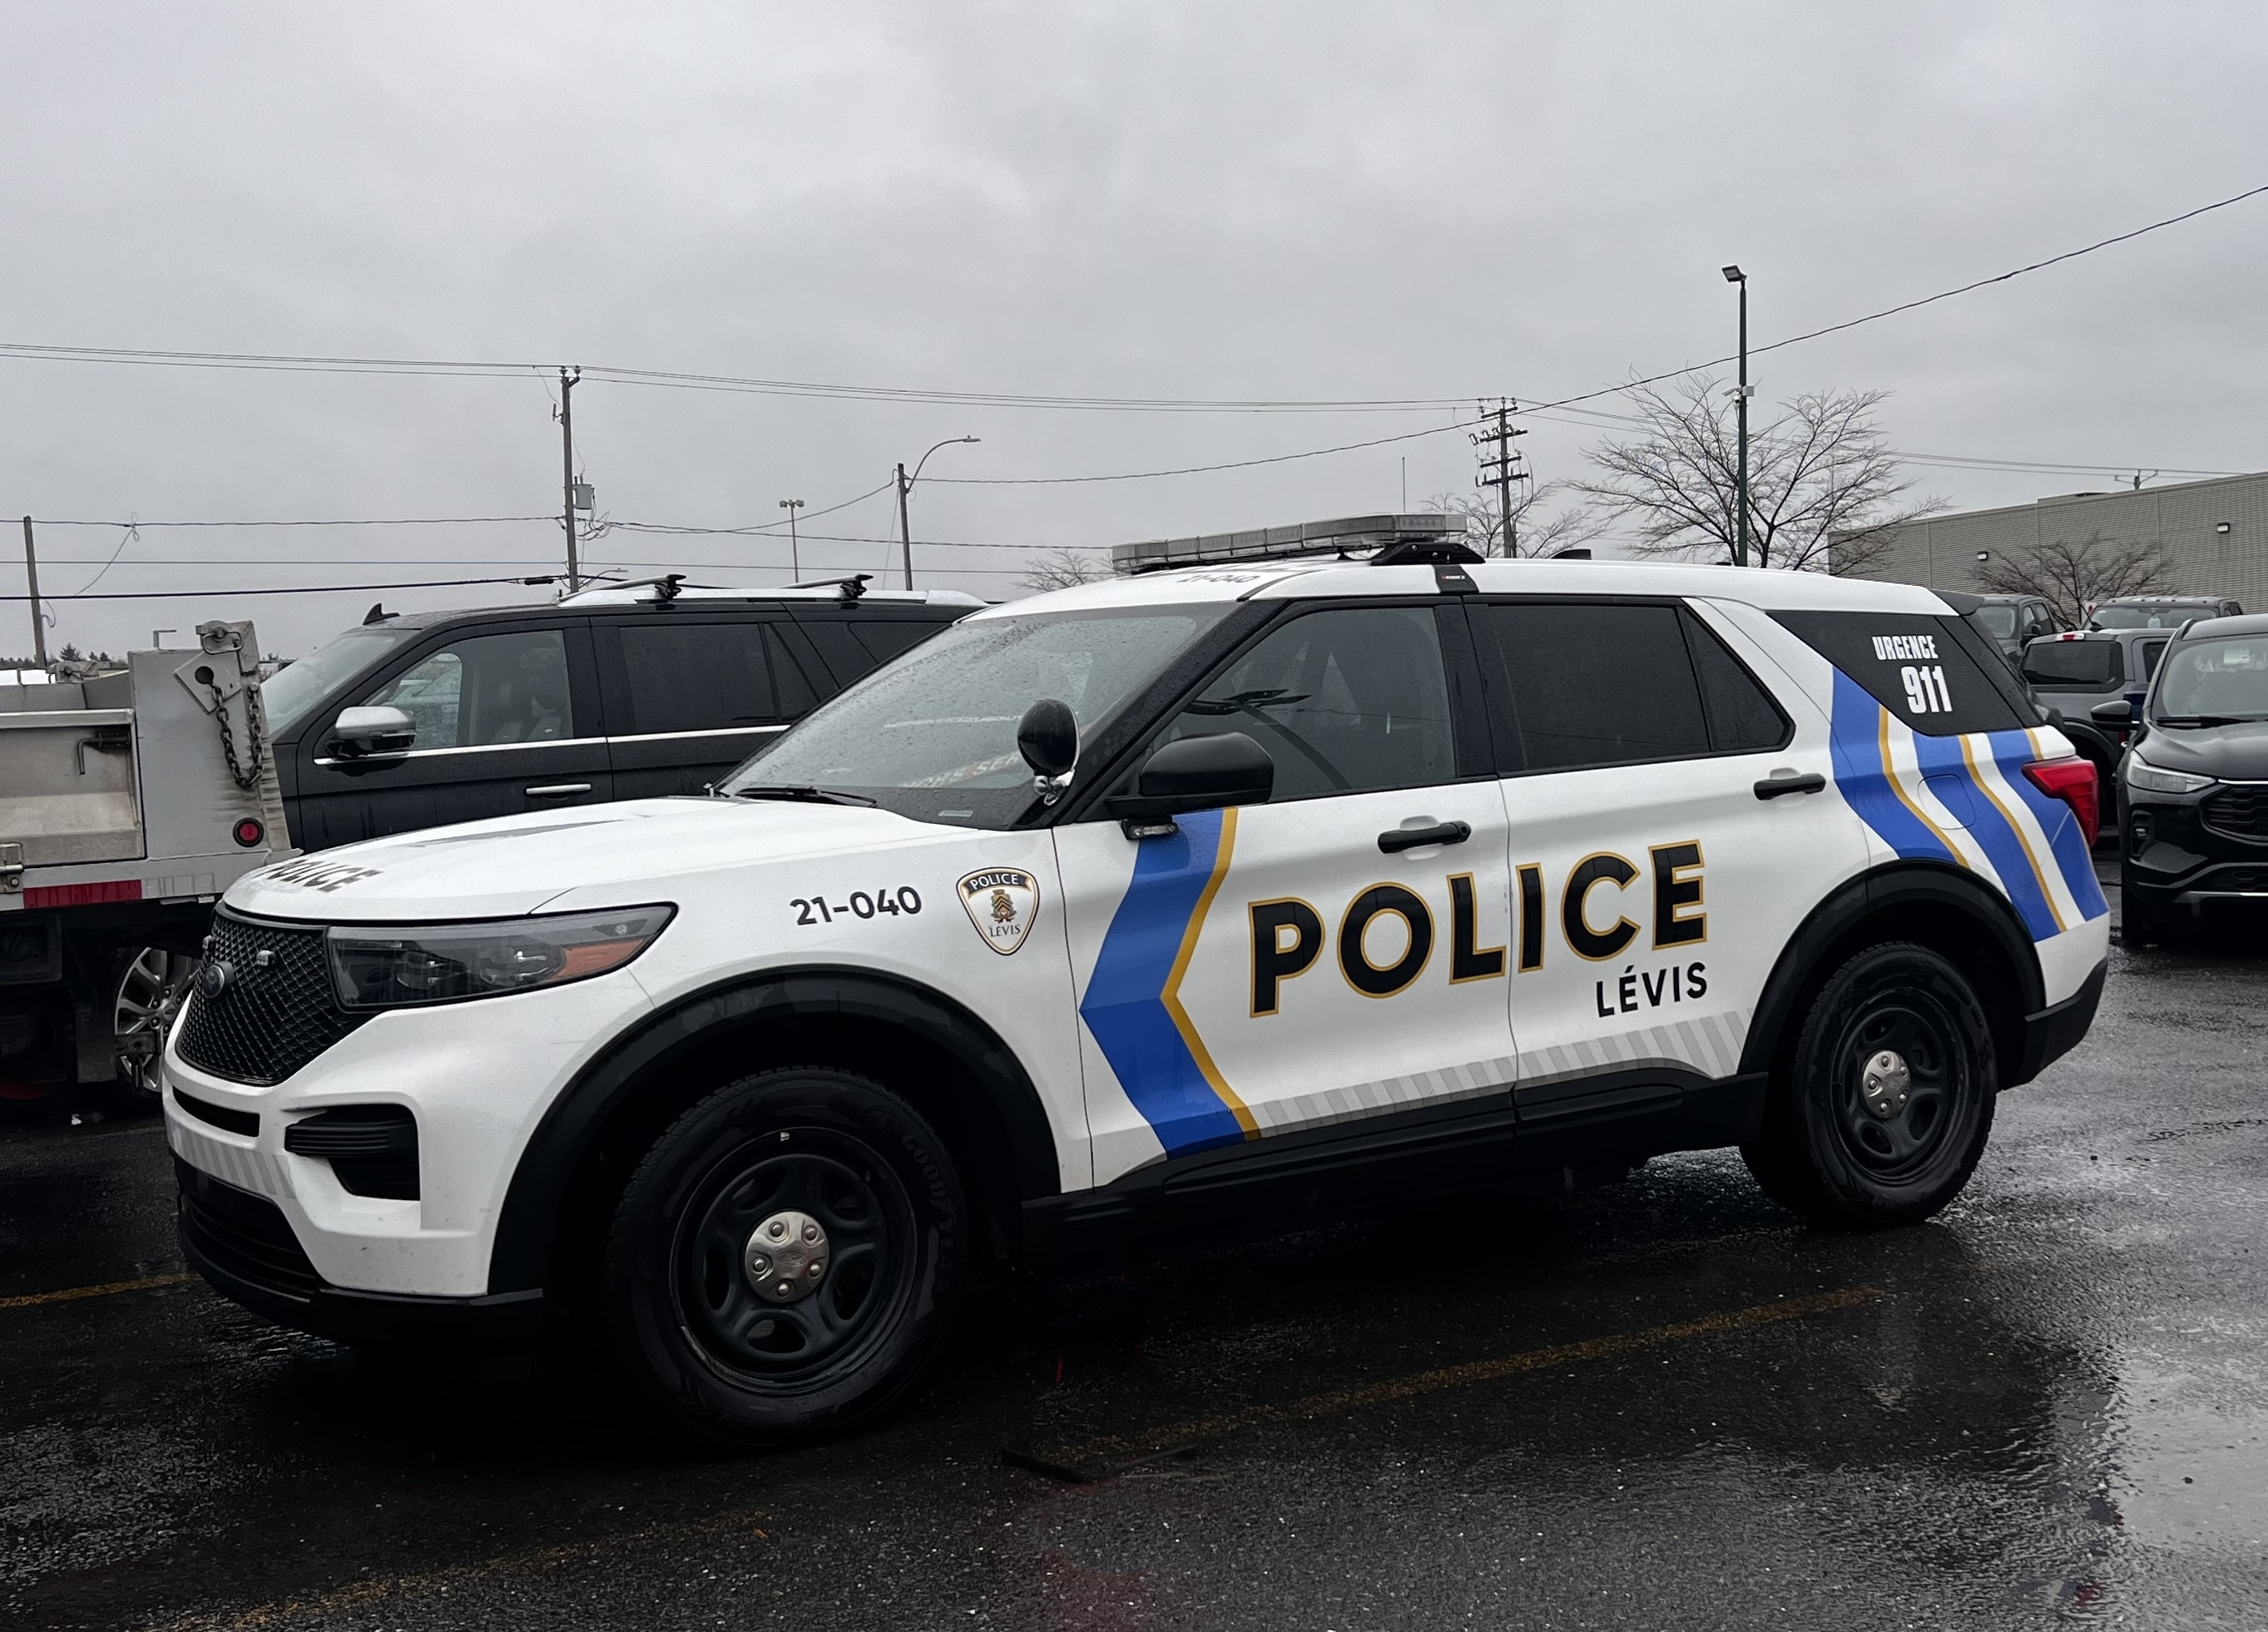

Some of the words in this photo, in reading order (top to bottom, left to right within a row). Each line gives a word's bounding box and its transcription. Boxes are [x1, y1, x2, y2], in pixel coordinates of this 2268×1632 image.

[1871, 635, 1939, 661] URGENCE
[1900, 665, 1953, 714] 911
[251, 858, 384, 893] POLICE
[969, 872, 1020, 891] POLICE
[790, 885, 922, 925] 21-040
[1249, 839, 1707, 1019] POLICE
[1596, 961, 1707, 1018] LÉVIS
